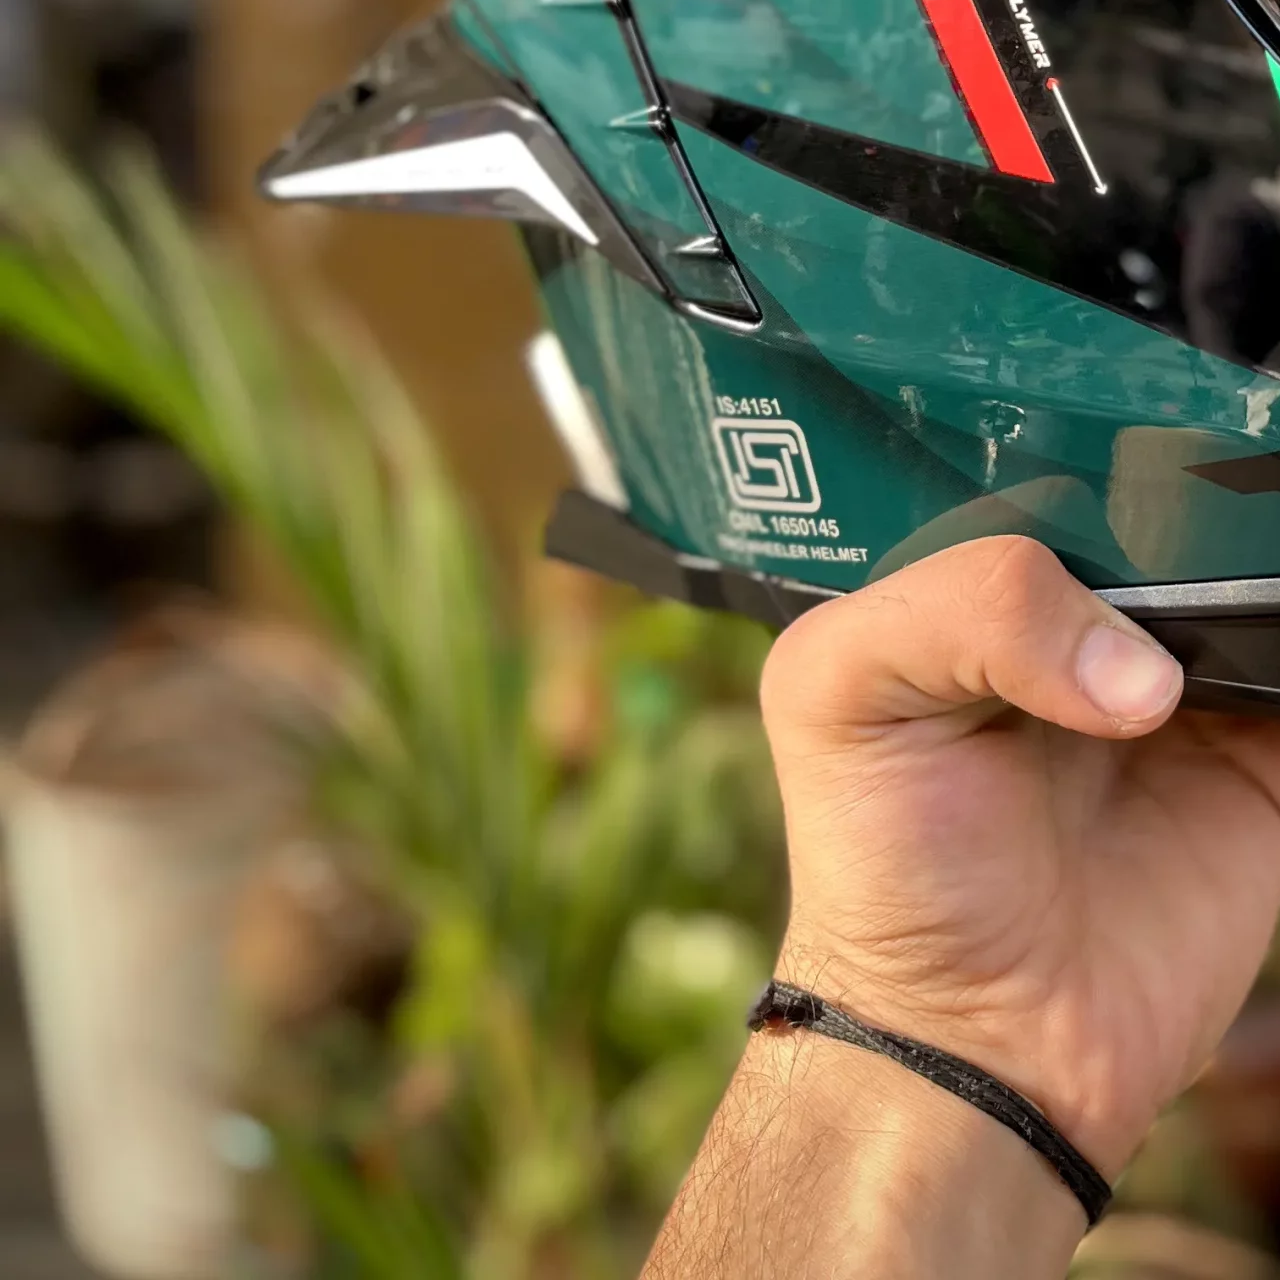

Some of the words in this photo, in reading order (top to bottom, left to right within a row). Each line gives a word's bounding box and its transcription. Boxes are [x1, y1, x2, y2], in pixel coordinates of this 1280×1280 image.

[715, 395, 783, 416] IS:4151
[769, 516, 841, 539] 1650145
[810, 546, 869, 562] HELMET
